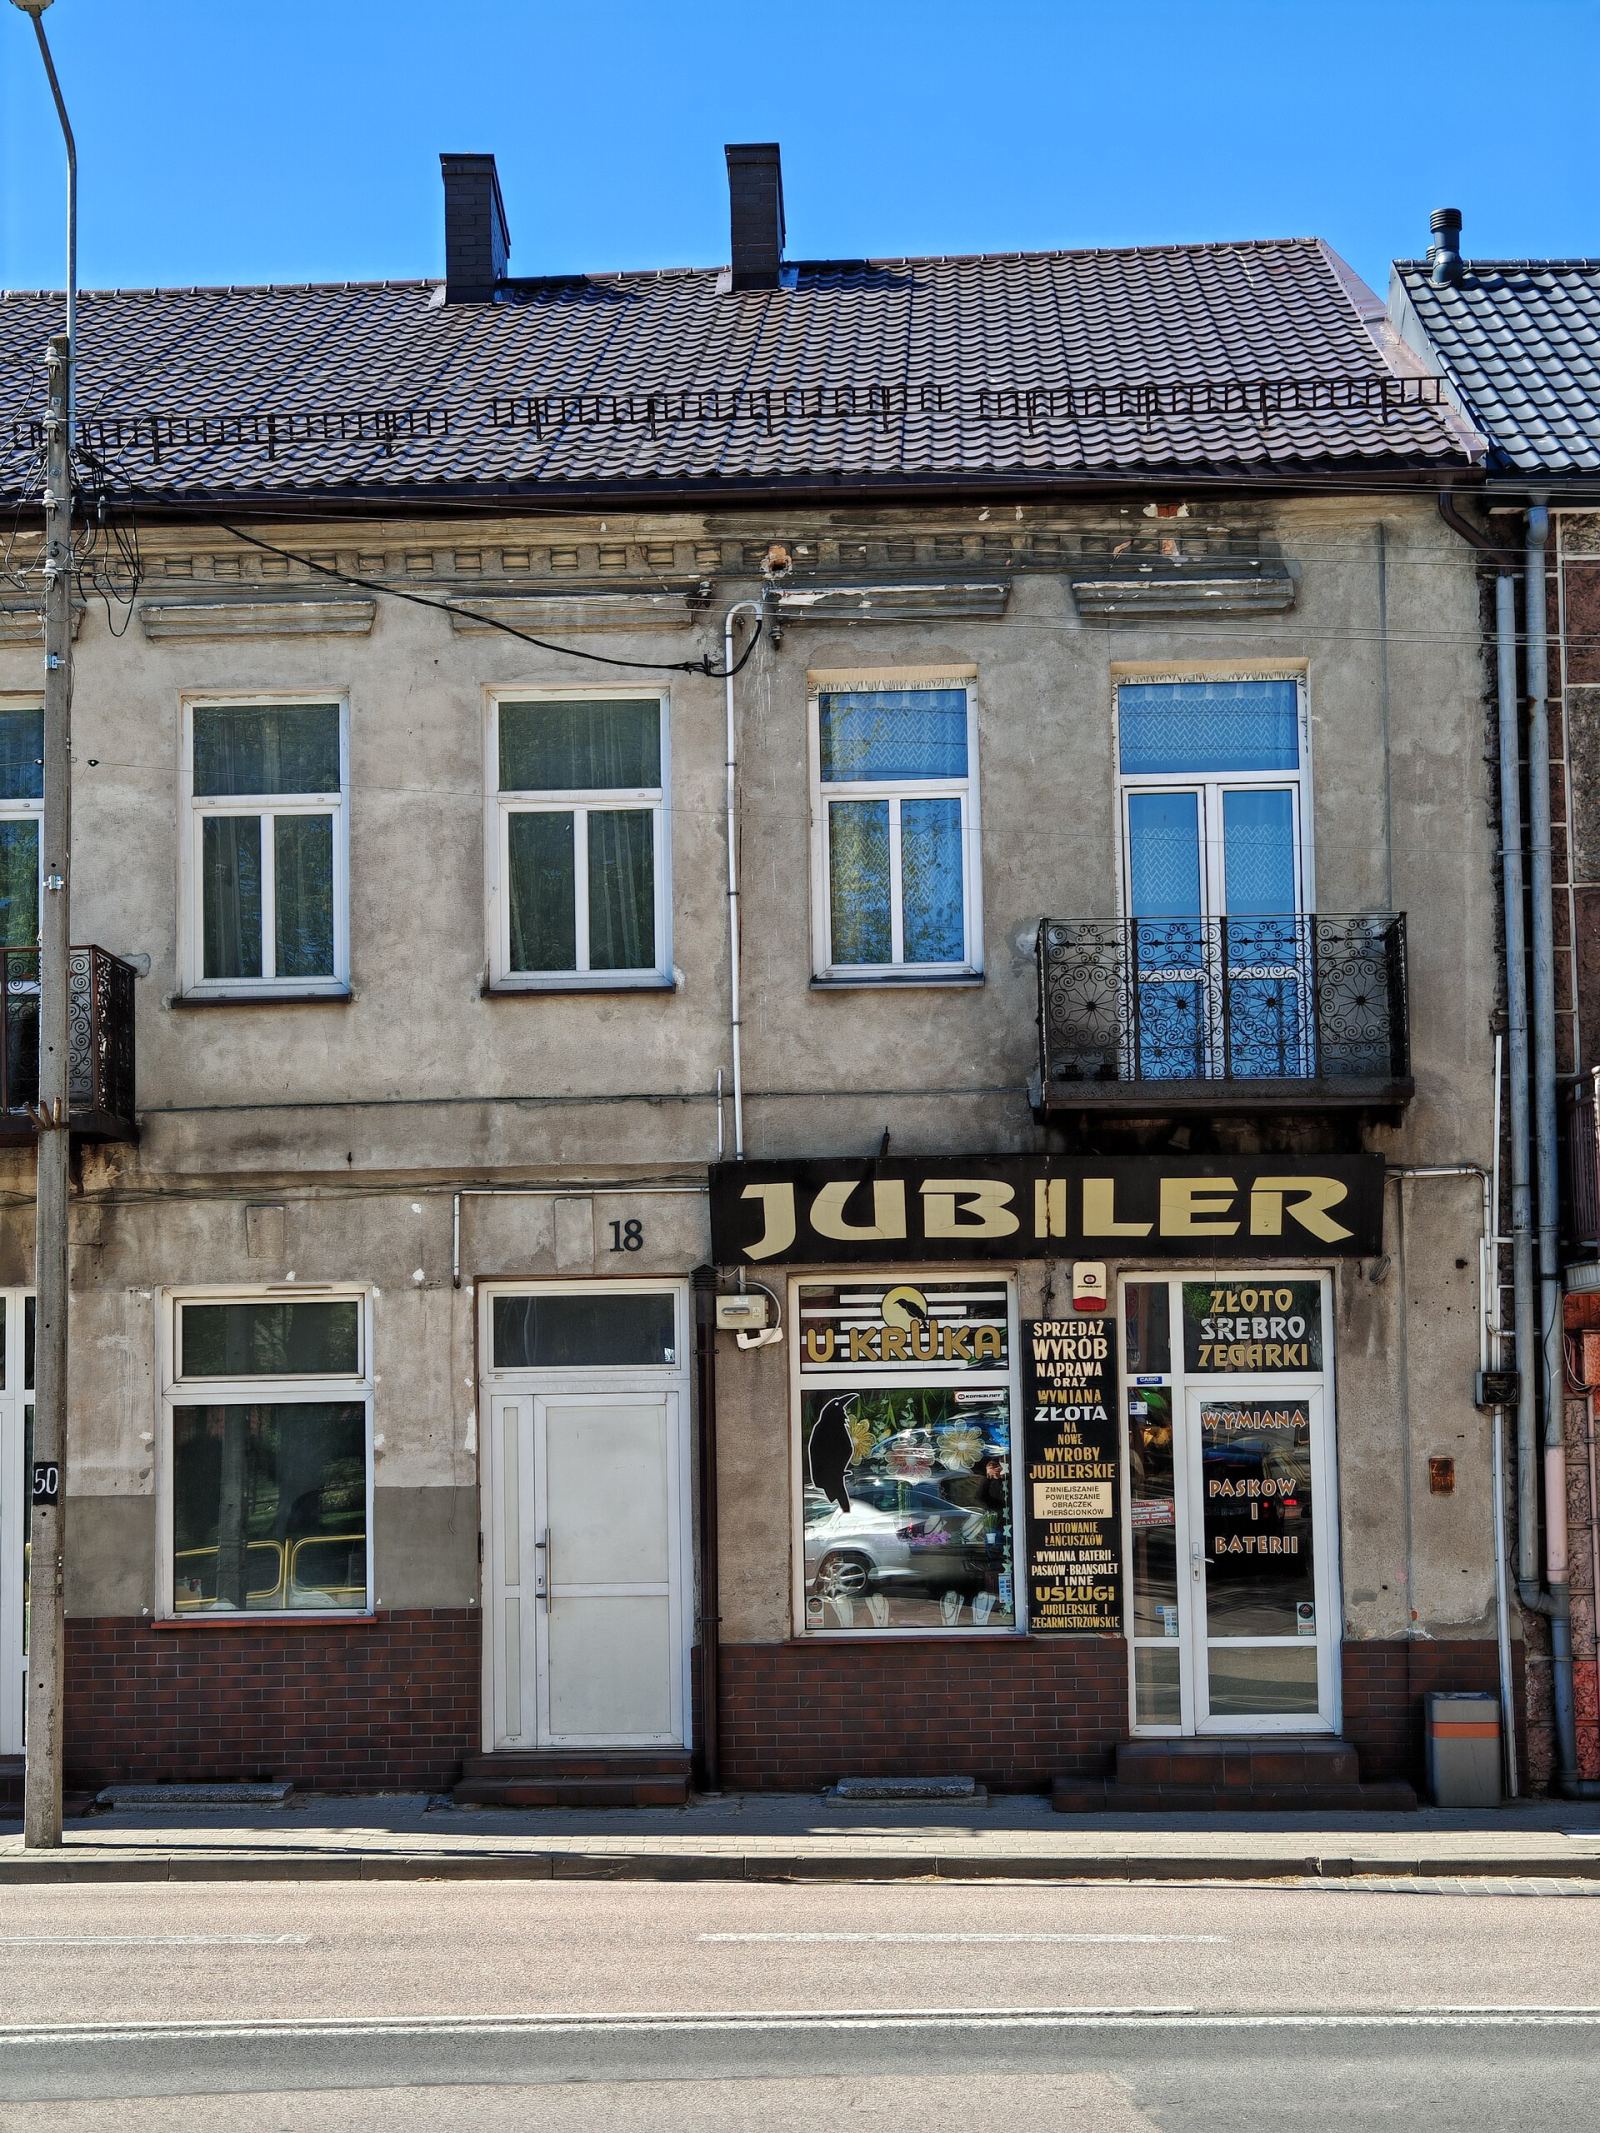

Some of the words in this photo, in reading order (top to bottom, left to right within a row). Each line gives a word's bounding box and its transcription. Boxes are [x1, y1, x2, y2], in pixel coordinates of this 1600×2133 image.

[740, 1176, 1355, 1261] JUBILER
[609, 1219, 643, 1252] 18
[1210, 1288, 1293, 1313] ZŁOTO
[1033, 1319, 1104, 1337] SPRZEDAŻ
[1200, 1316, 1306, 1342] SREBRO
[807, 1328, 835, 1362] U
[849, 1319, 1002, 1362] KRUKA
[1032, 1335, 1108, 1361] WYRÓB
[1198, 1343, 1308, 1369] ZEGARKI
[1036, 1361, 1103, 1378] NAPRAWA
[1053, 1377, 1087, 1388] ORAZ
[1037, 1389, 1102, 1405] WYMIANA
[1034, 1405, 1108, 1422] ZŁOTA
[1201, 1408, 1306, 1431] WYMIANA
[1063, 1422, 1077, 1433] NA
[1057, 1433, 1084, 1445] NOWE
[1043, 1446, 1100, 1462] WYROBY
[1029, 1463, 1116, 1480] JUBILERSKIE
[33, 1467, 59, 1494] 50
[1045, 1485, 1100, 1493] ZMNIEJSZANIE
[1209, 1478, 1297, 1498] PASKOW
[1045, 1493, 1101, 1501] POWIĘKSZANIE
[1051, 1501, 1093, 1509] OBRĄCZEK
[1046, 1508, 1105, 1516] PIERŚCIONKÓW
[1250, 1502, 1259, 1521] I
[1049, 1522, 1099, 1534] LUTOWANIE
[1214, 1534, 1299, 1555] BATERII
[1036, 1550, 1077, 1562] WYMIANA
[1055, 1577, 1060, 1586] I
[1064, 1576, 1094, 1586] INNE
[1035, 1586, 1115, 1602] USŁUGI
[1040, 1603, 1098, 1616] JUBILERSKIE
[1104, 1603, 1108, 1615] I
[1031, 1616, 1120, 1629] ZEGARMISTRZOWSKIE
